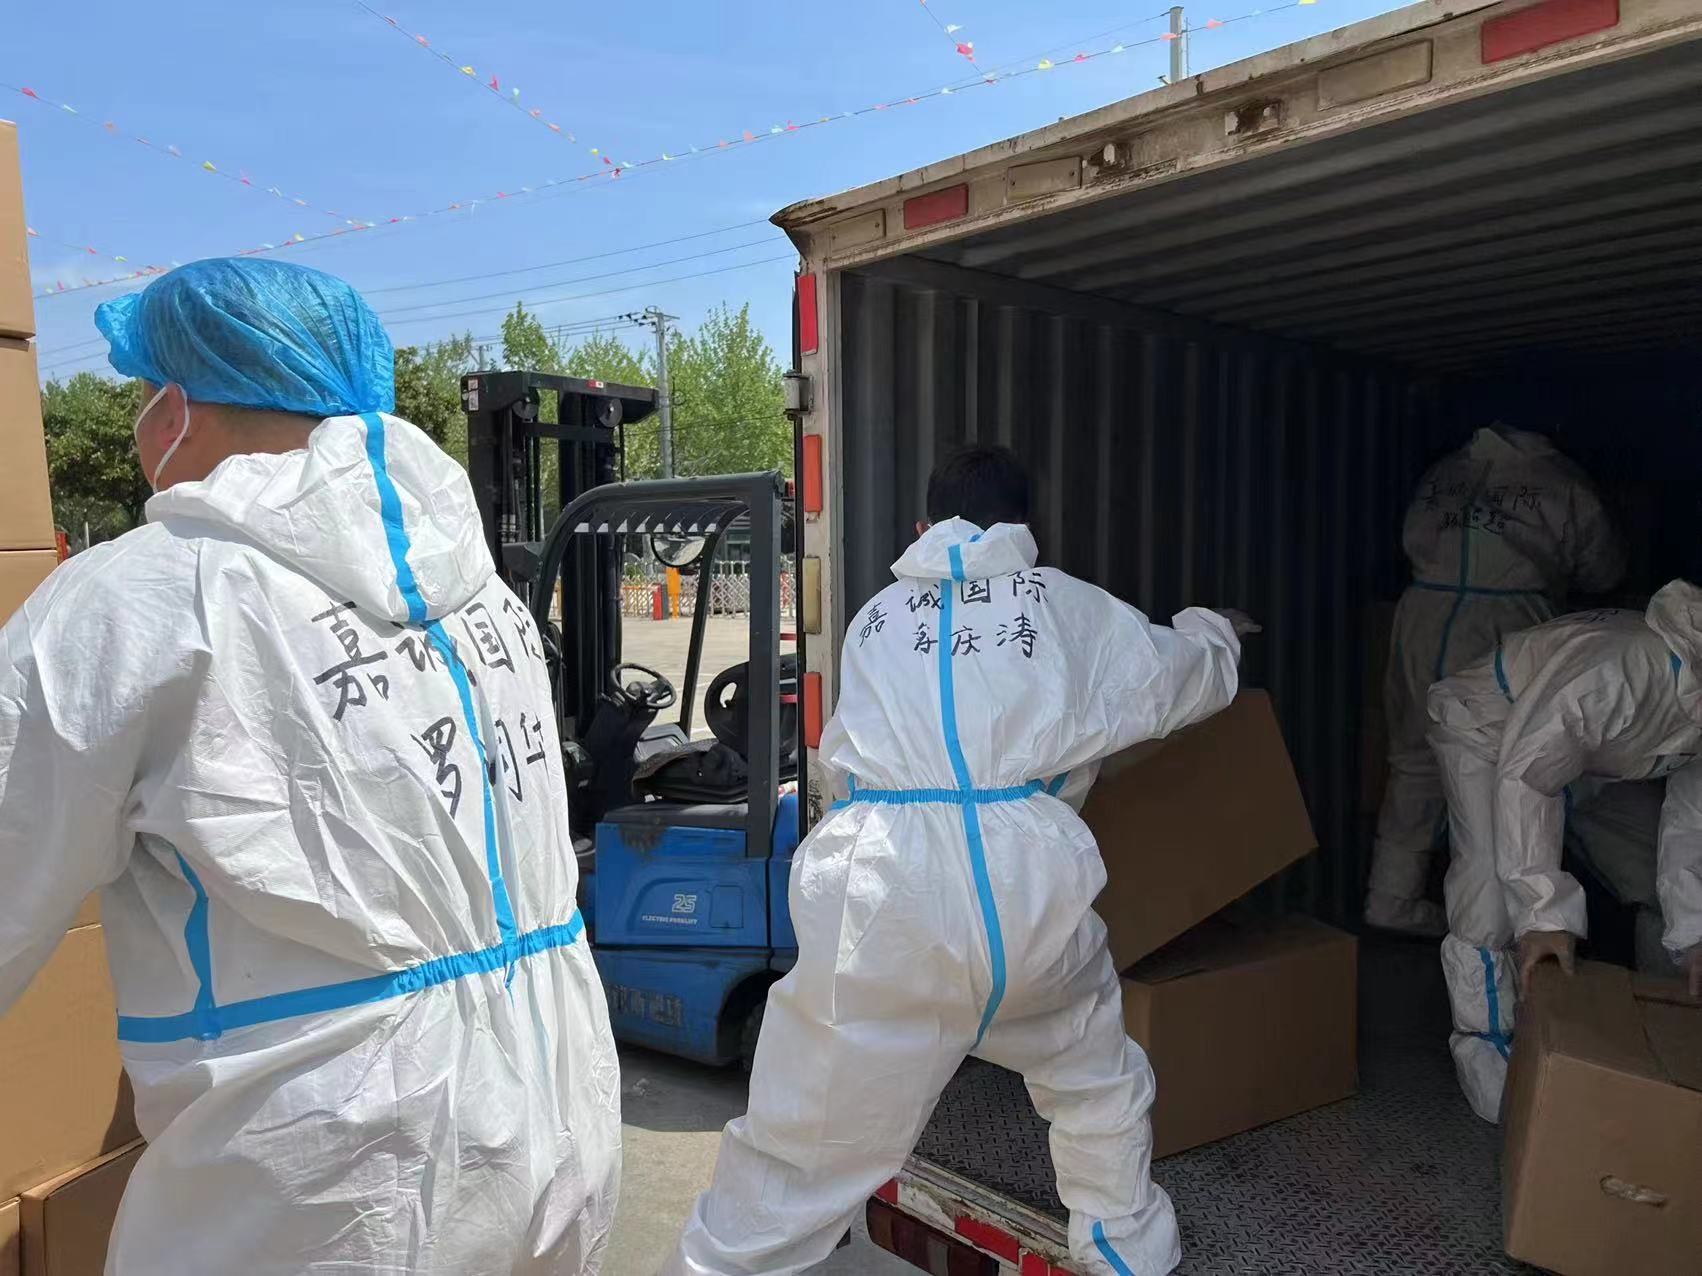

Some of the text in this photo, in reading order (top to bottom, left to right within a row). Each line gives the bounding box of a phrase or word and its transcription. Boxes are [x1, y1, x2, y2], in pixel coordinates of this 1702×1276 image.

[859, 571, 1049, 648] 嘉诚国际
[671, 893, 698, 913] 25
